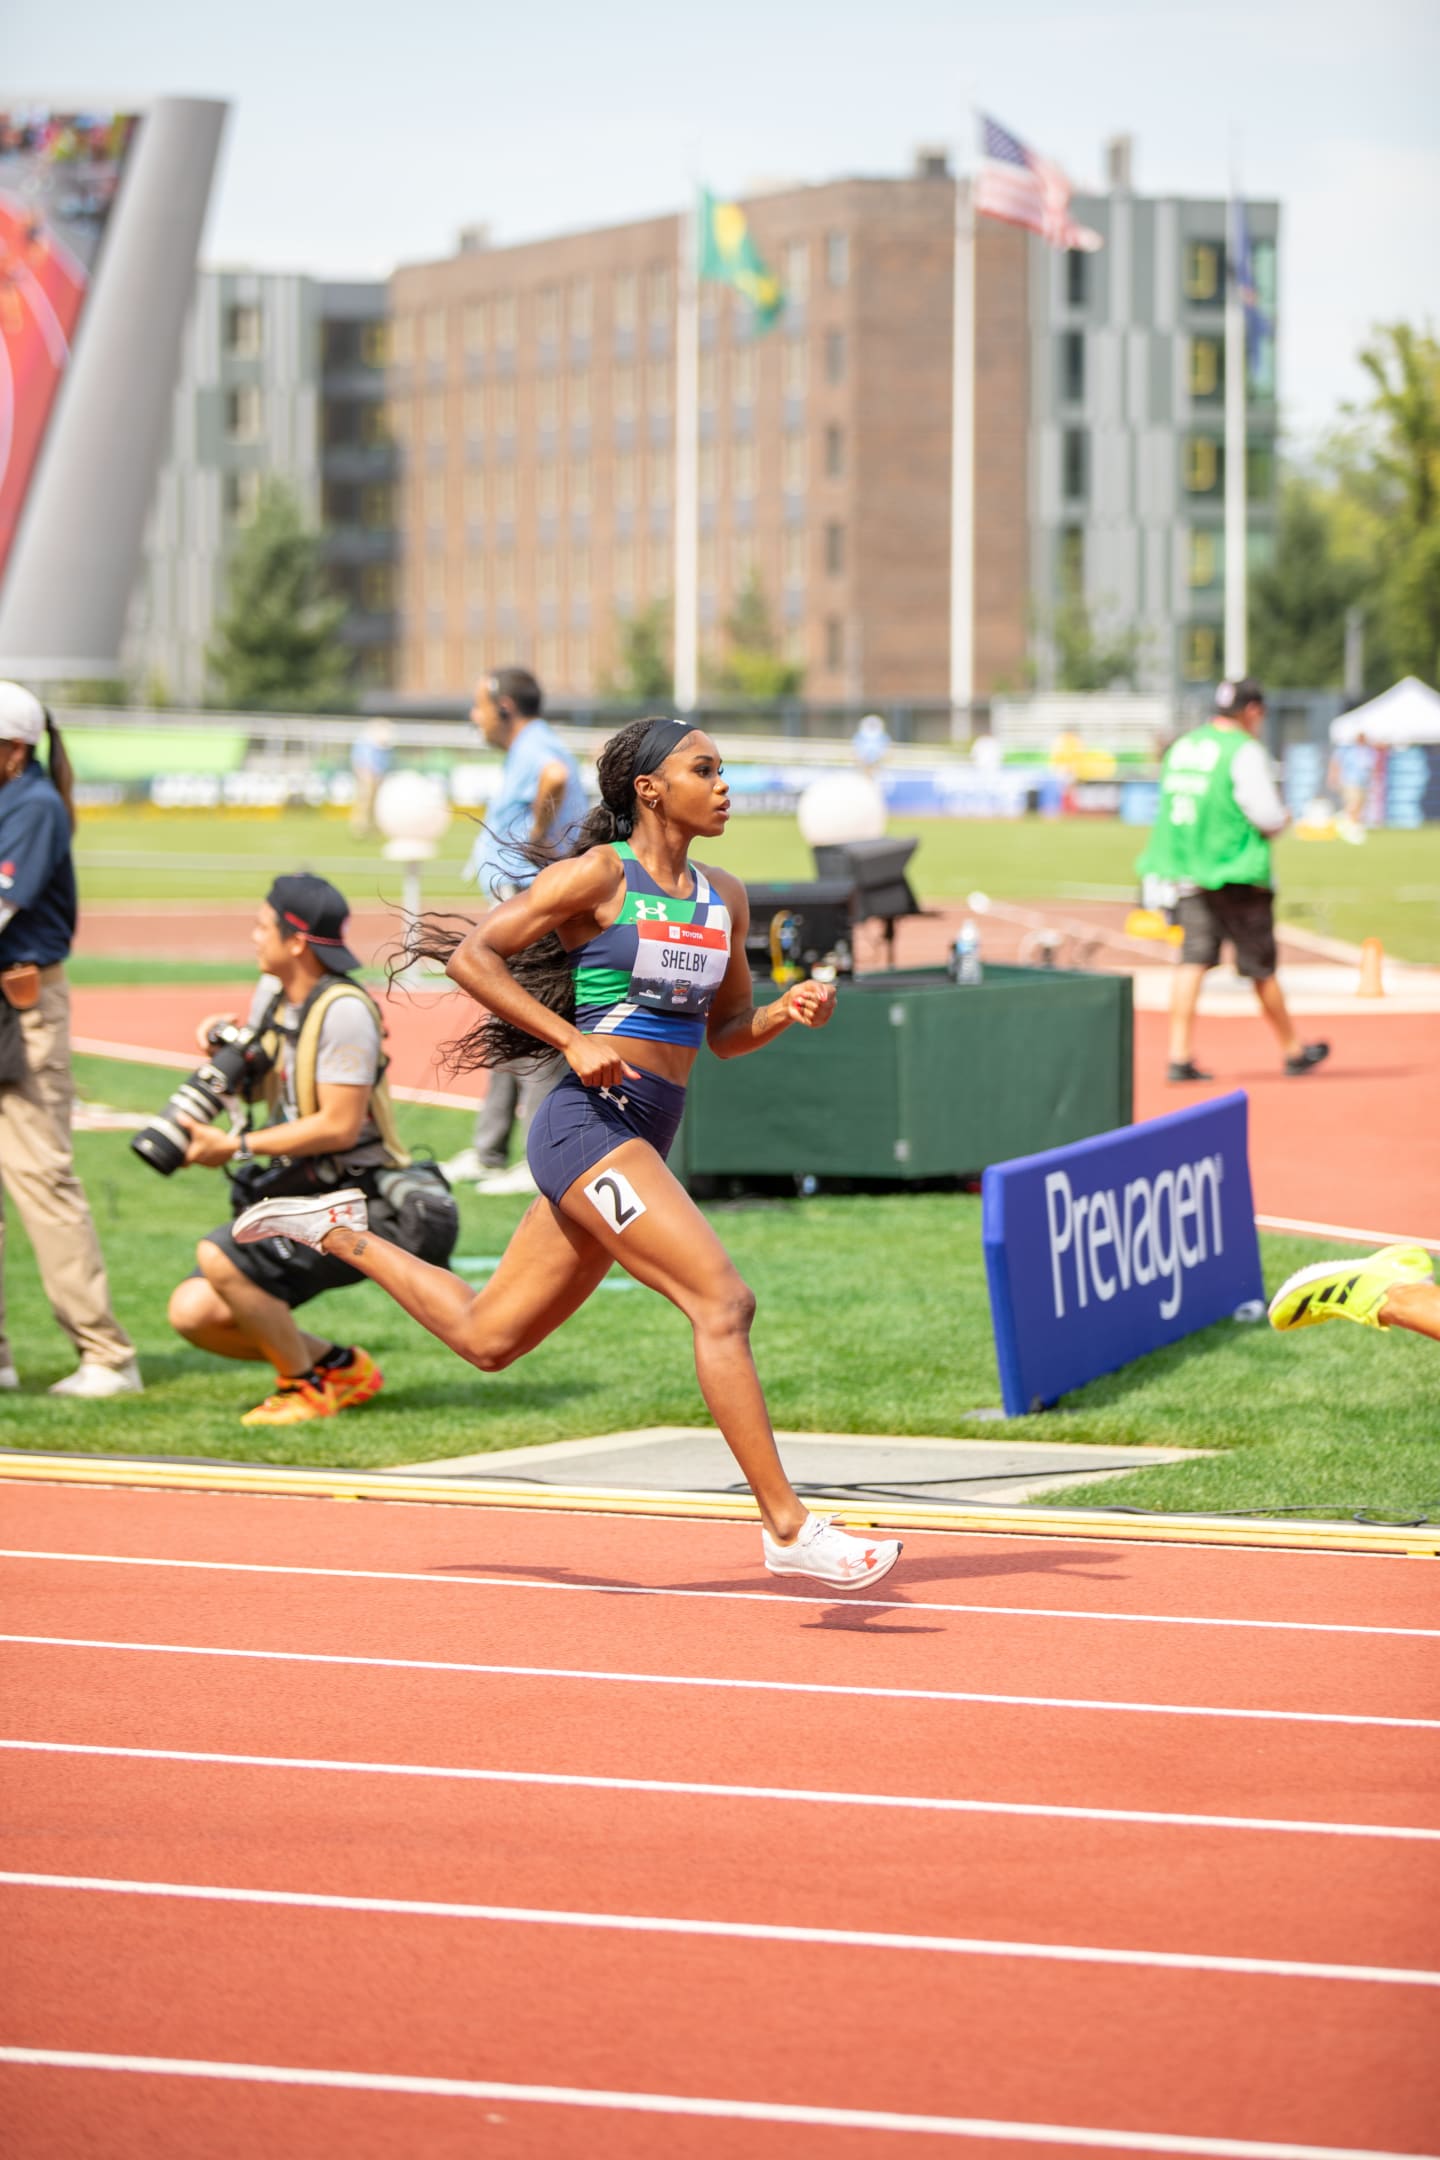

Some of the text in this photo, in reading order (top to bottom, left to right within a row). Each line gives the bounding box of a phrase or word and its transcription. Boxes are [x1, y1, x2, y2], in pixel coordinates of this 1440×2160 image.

[681, 930, 704, 940] TOYOTA
[661, 948, 708, 973] SHELBY
[594, 1176, 637, 1226] 2
[1045, 1159, 1222, 1320] Prevagen
